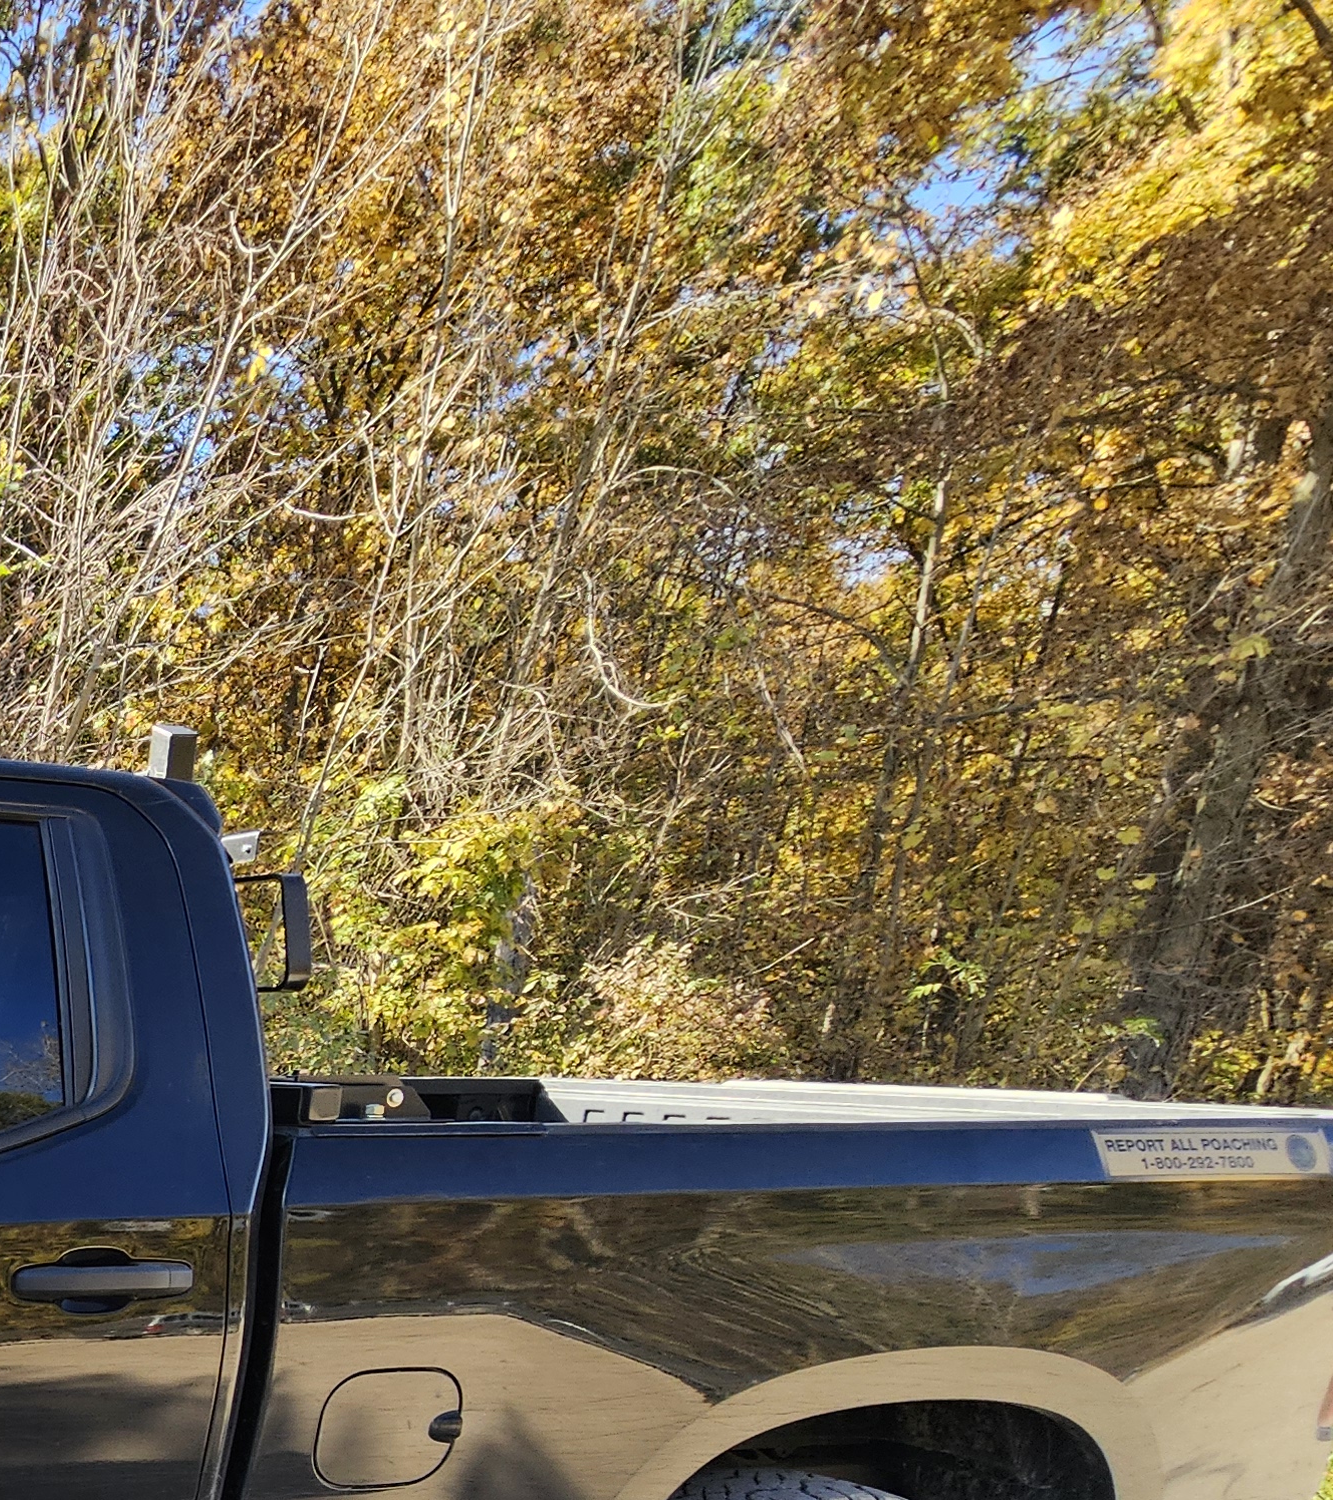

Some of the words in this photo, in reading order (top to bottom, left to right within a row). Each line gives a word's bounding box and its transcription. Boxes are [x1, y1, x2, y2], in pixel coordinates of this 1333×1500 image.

[1104, 1138, 1165, 1152] REPORT
[1170, 1138, 1198, 1151] ALL
[1202, 1137, 1278, 1151] POACHING
